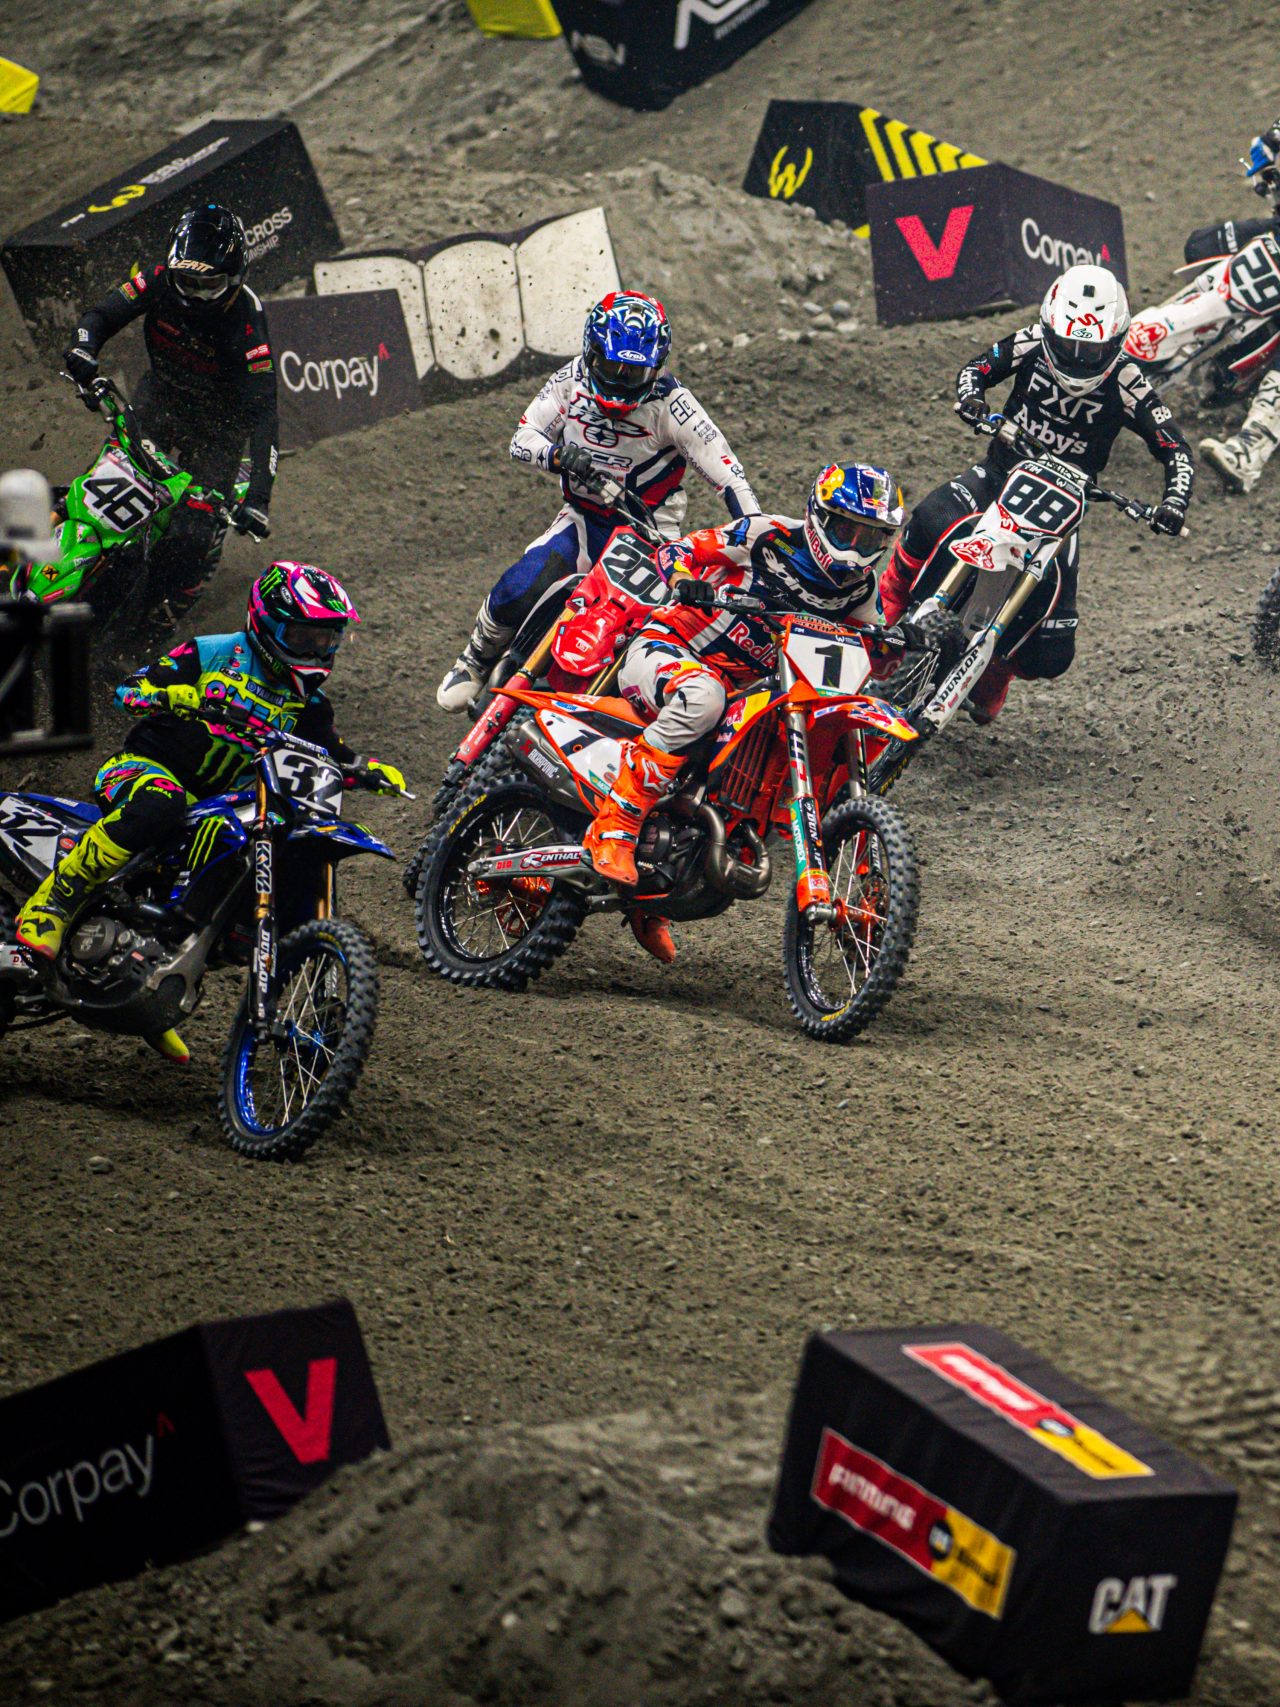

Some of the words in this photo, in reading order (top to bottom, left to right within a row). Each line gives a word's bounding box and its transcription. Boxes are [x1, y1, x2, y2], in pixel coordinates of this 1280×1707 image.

[170, 259, 215, 273] LEATT
[279, 350, 381, 400] Corpay
[1027, 372, 1104, 425] FXR
[1013, 403, 1088, 455] Arby's
[1151, 405, 1172, 425] 88
[82, 476, 158, 534] 46
[1000, 473, 1079, 533] 88
[814, 644, 844, 689] 1
[939, 649, 979, 703] DUNLOP
[278, 754, 343, 816] 32
[520, 851, 582, 869] RENTHAL
[792, 819, 807, 864] MOTOREX
[258, 930, 271, 993] DUNLOP
[1088, 1574, 1179, 1635] CAT
